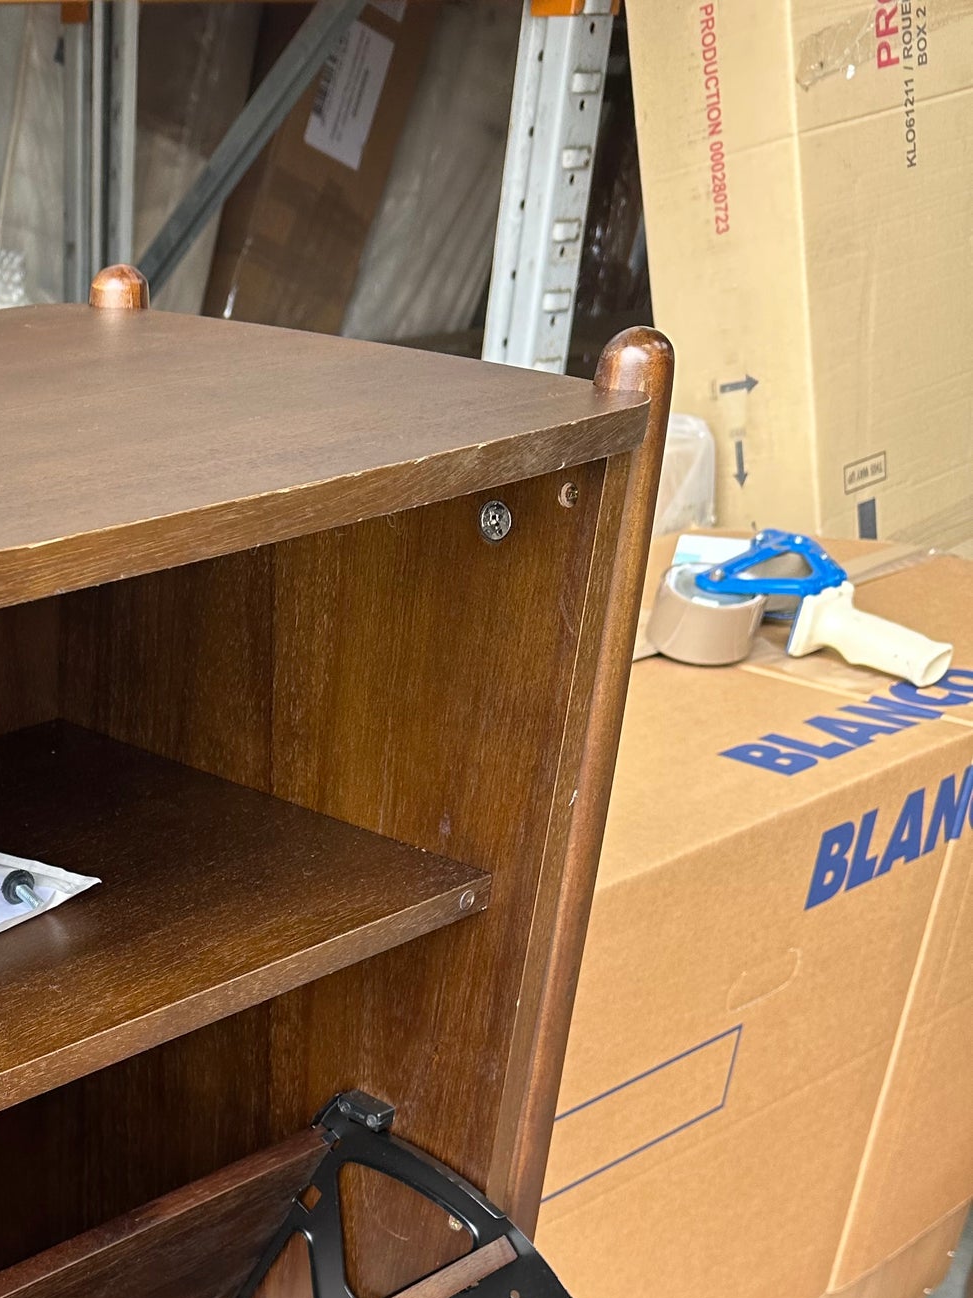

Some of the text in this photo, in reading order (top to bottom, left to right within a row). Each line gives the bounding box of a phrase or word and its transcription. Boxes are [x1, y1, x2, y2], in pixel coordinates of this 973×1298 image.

[875, 0, 900, 69] PR
[900, 0, 913, 61] ROUE
[915, 5, 928, 66] BOX 2
[700, 3, 730, 235] PRODUCTION 000280723
[903, 78, 917, 168] KLO61211
[804, 764, 973, 911] BLAN
